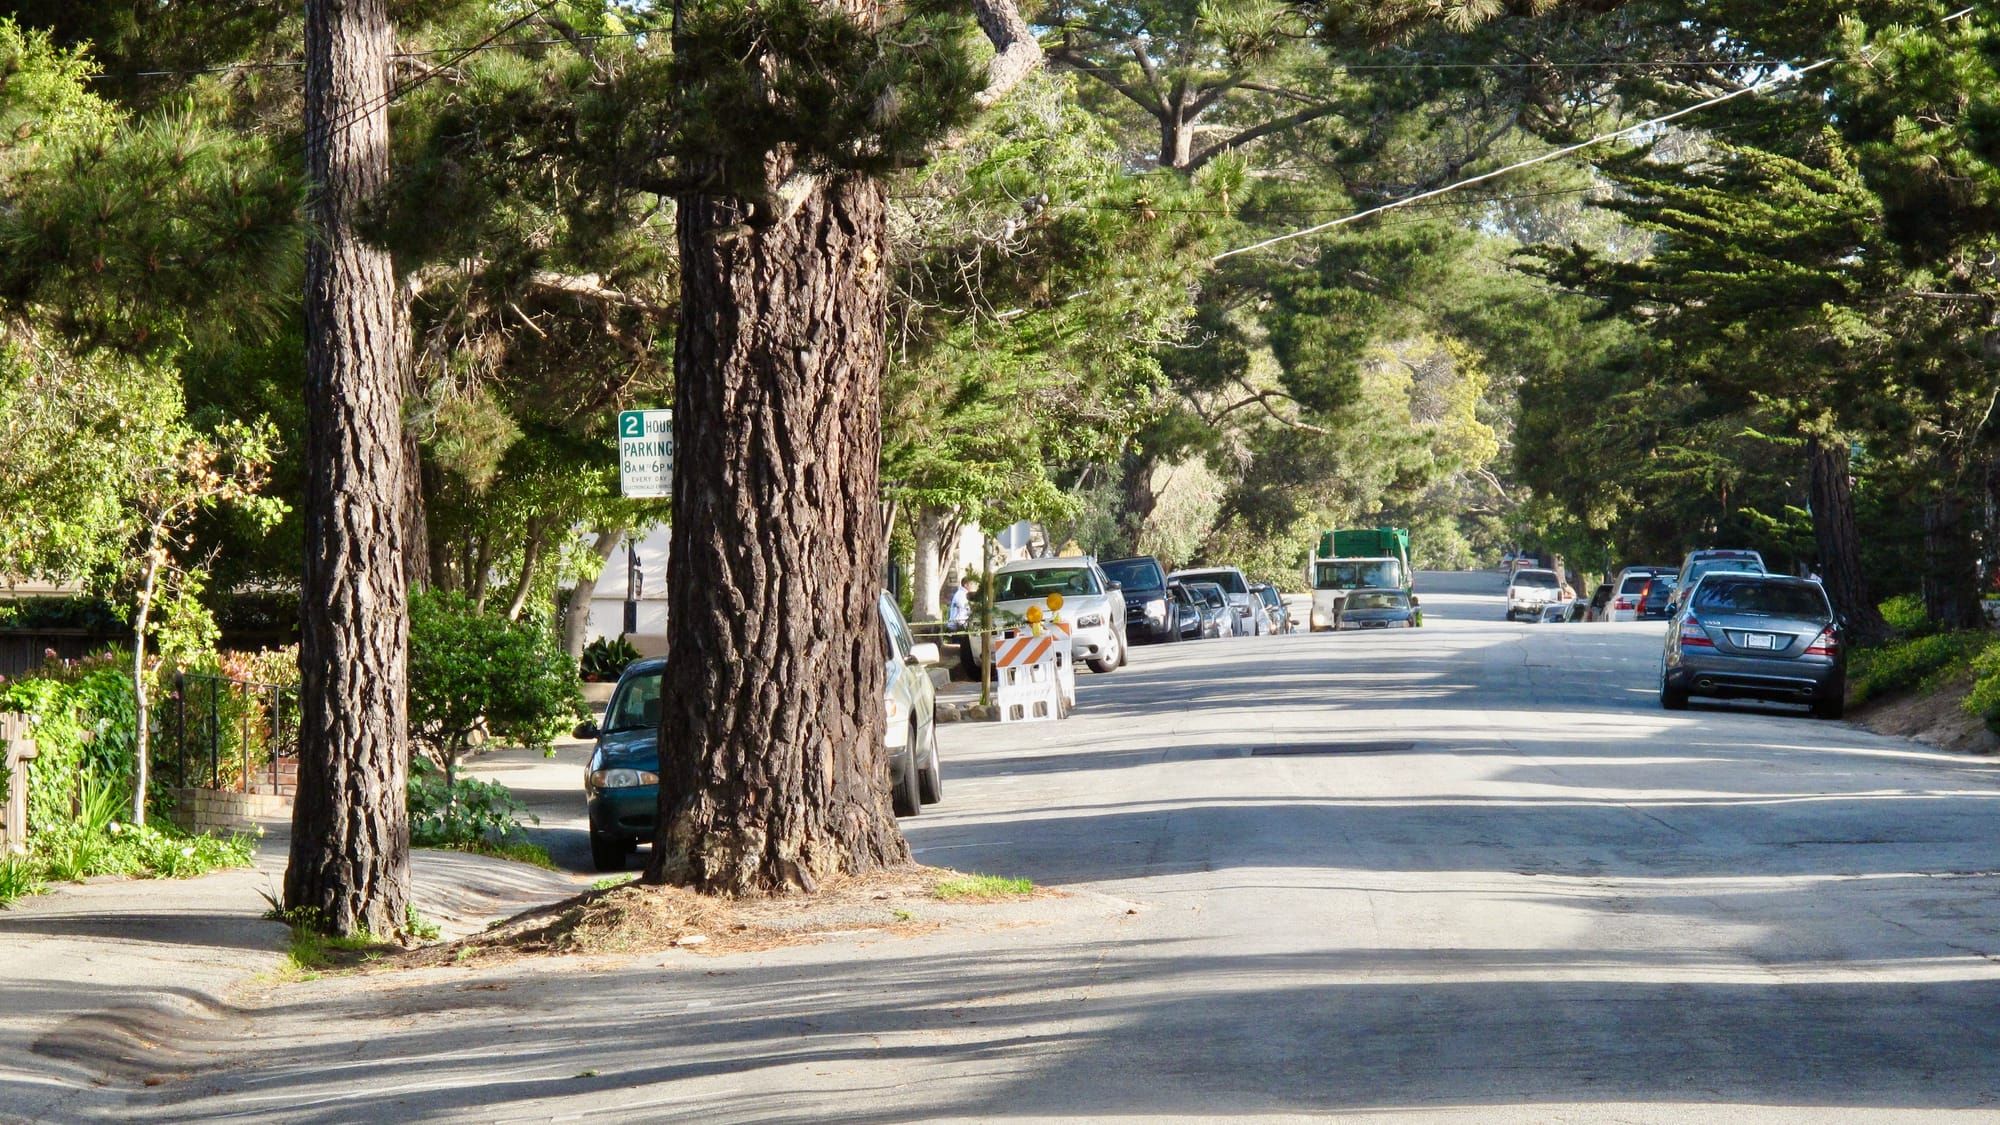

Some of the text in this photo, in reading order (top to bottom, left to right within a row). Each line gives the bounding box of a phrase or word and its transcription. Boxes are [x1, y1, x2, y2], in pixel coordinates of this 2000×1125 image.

[625, 416, 672, 435] 2 HOUR
[624, 441, 672, 457] PARKING
